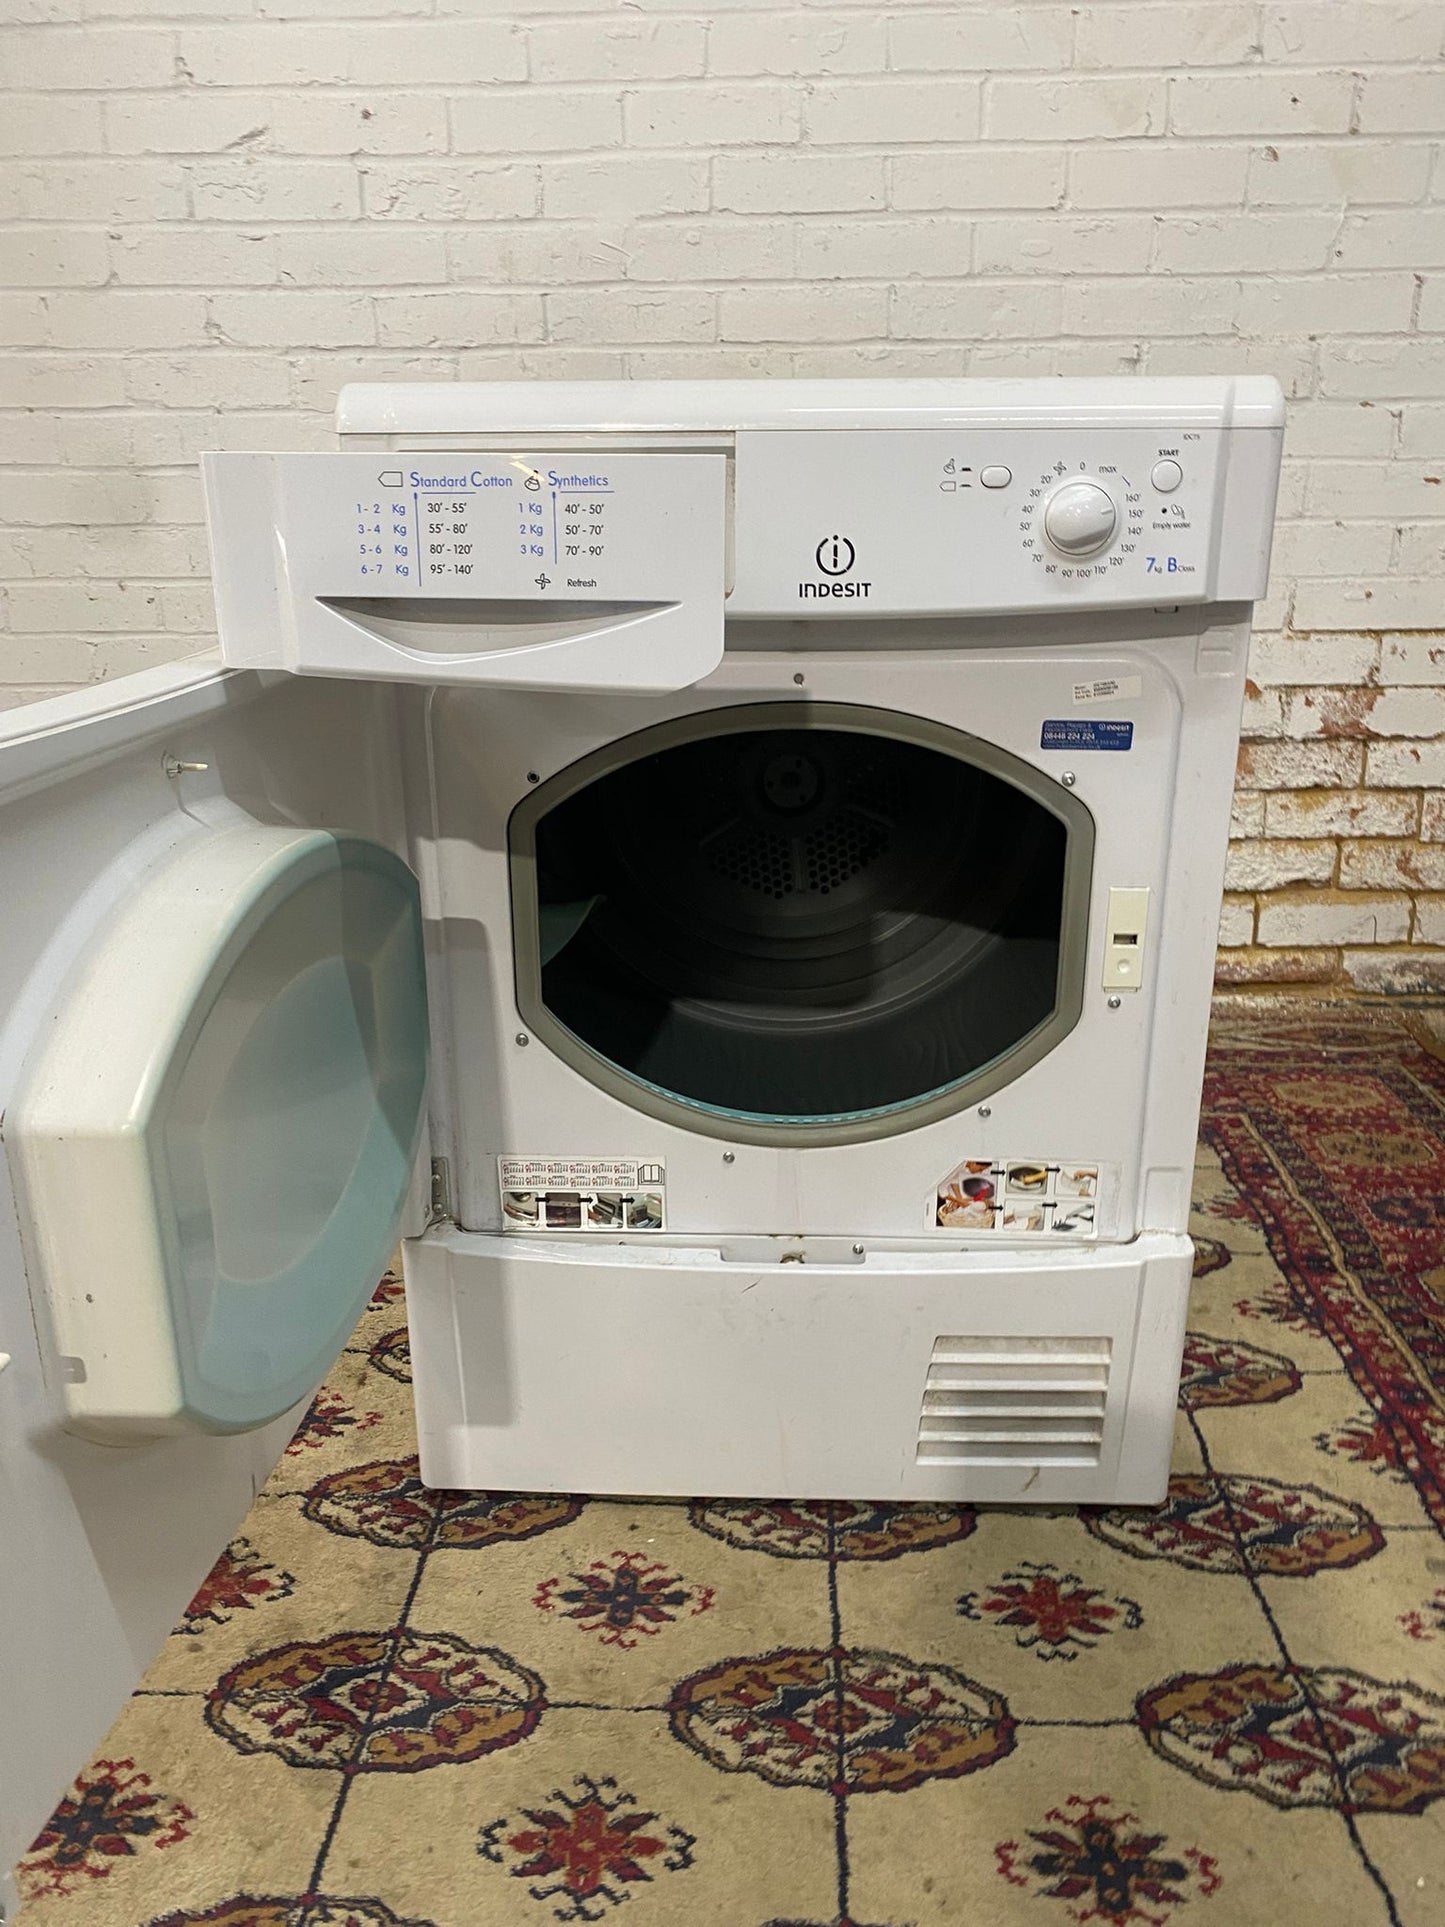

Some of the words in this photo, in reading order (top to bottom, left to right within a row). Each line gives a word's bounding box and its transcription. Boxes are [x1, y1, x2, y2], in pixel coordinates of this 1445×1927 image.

[1080, 461, 1085, 471] 0
[1099, 465, 1117, 473] max
[410, 472, 466, 487] Standard
[471, 471, 513, 487] Cotton
[548, 470, 608, 488] Synthetics
[373, 504, 380, 514] 2
[392, 504, 406, 516] Kg
[519, 502, 523, 512] 1
[529, 503, 542, 515] Kg
[374, 524, 381, 534] 4
[393, 524, 407, 536] Kg
[520, 524, 526, 534] 2
[530, 524, 543, 536] Kg
[375, 544, 382, 554] 6
[394, 544, 408, 556] Kg
[521, 545, 526, 554] 3
[530, 545, 544, 557] Kg
[376, 564, 382, 574] 7
[395, 565, 409, 576] Kg
[567, 579, 597, 587] Refresh
